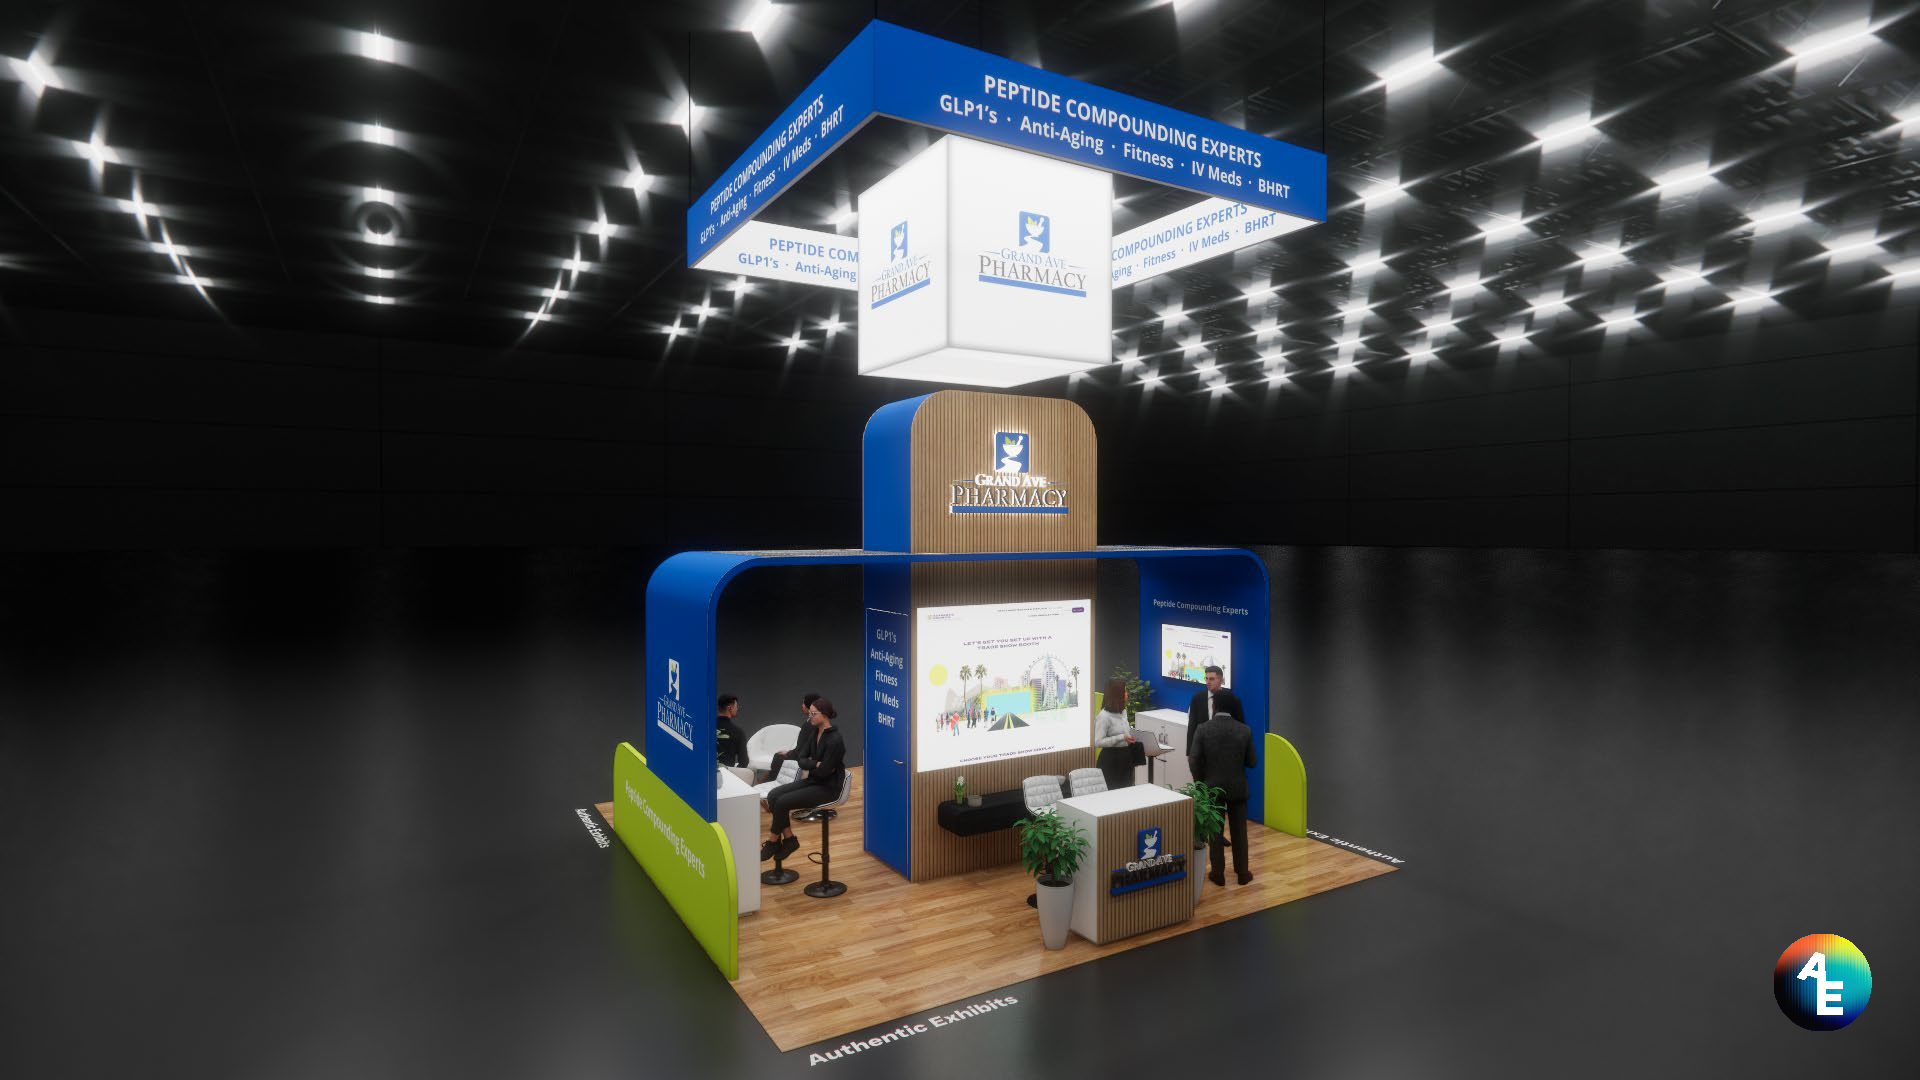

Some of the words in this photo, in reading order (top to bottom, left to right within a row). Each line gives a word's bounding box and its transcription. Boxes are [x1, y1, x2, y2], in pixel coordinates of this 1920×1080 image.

[984, 74, 1061, 113] PEPTIDE
[1066, 99, 1197, 151] COMPOUNDING
[1202, 136, 1262, 168] EXPERTS
[710, 182, 733, 215] PEPTIDE
[733, 130, 787, 189] COMPOUNDING
[788, 94, 824, 142] EXPERTS
[939, 94, 998, 124] GLP1's
[1020, 115, 1104, 156] Anti-Aging
[1123, 142, 1174, 169] Fitness
[1192, 160, 1205, 177] IV
[1208, 164, 1242, 187] Meds
[1258, 178, 1290, 199] BHRT
[720, 195, 748, 228] Anti-Aging
[754, 169, 775, 197] Fitness
[783, 152, 790, 171] IV
[792, 136, 811, 164] Meds
[821, 104, 844, 138] BHRT
[769, 238, 825, 258] PEPTIDE
[1112, 221, 1193, 261] COMPOUNDING
[1196, 202, 1248, 231] EXPERTS
[1143, 249, 1176, 269] Fitness
[1189, 240, 1199, 254] IV
[1201, 230, 1230, 250] Meds
[1245, 212, 1277, 234] BHRT
[738, 252, 779, 269] GLP1's
[795, 261, 857, 283] Anti-Aging
[978, 254, 1087, 290] PHARMACY
[1001, 248, 1042, 266] GRAND
[1044, 252, 1067, 270] AVE
[872, 260, 930, 302] PHARMACY
[951, 484, 1067, 507] PHARMACY
[975, 473, 1021, 487] GRAND
[1023, 474, 1048, 488] AVE
[1153, 598, 1176, 609] Peptide
[1177, 601, 1222, 615] Compounding
[1222, 605, 1249, 616] Experts
[876, 628, 897, 643] GLP1's
[870, 648, 904, 670] Anti-Aging
[875, 670, 898, 687] Fitness
[874, 690, 881, 702] IV
[882, 692, 899, 709] Meds
[658, 701, 693, 741] PHARMACY
[878, 712, 896, 729] BHRT
[642, 799, 680, 855] Compounding
[680, 838, 705, 879] Experts
[809, 1023, 928, 1066] Authentic
[928, 995, 1018, 1028] Exhibits
